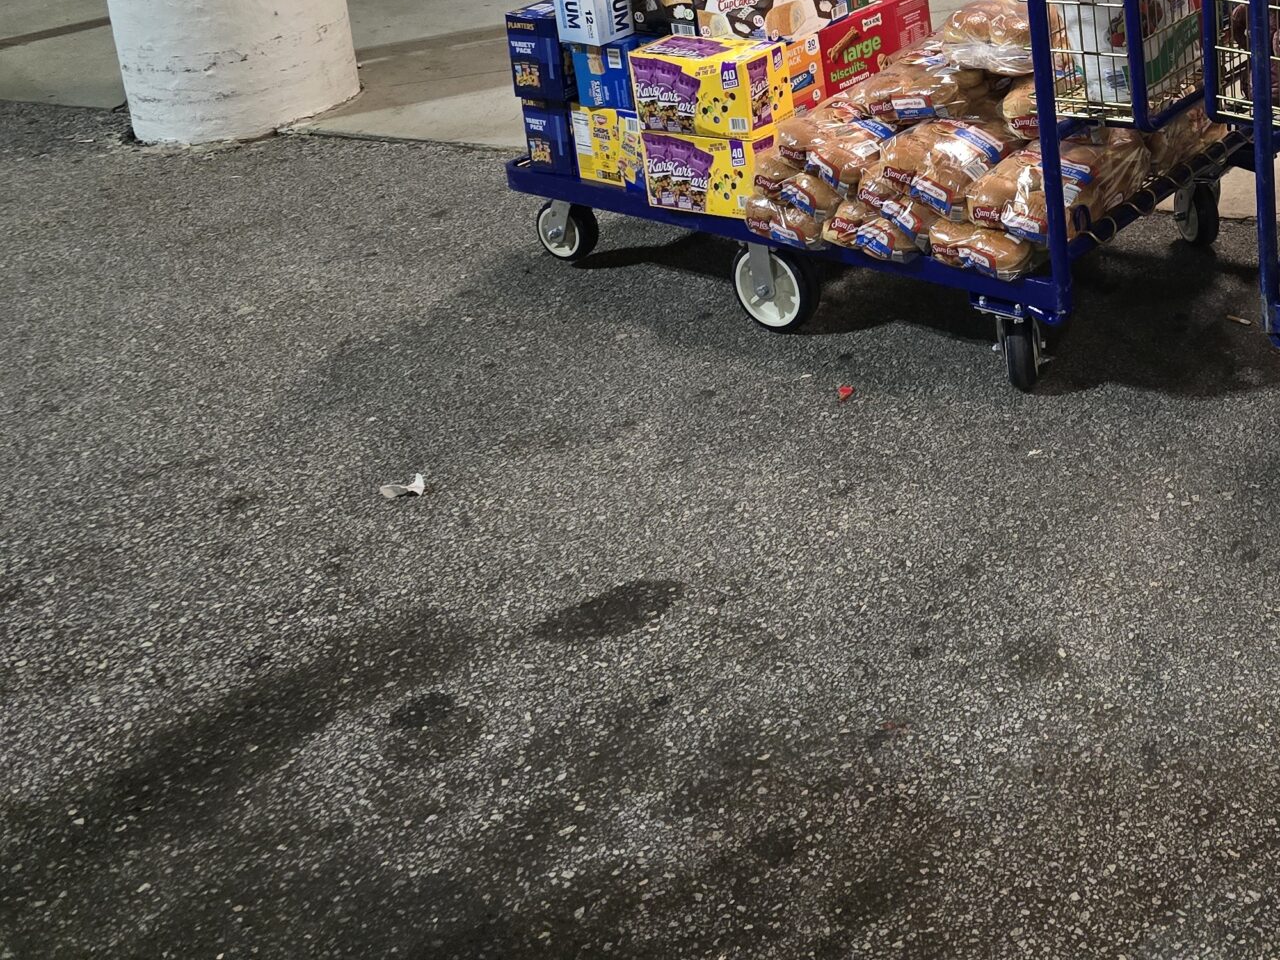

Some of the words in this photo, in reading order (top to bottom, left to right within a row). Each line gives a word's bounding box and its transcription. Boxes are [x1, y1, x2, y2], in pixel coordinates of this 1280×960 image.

[585, 9, 594, 24] 12
[754, 16, 762, 24] 16
[863, 16, 880, 26] MILK-BONE
[508, 22, 535, 30] PLANTERS
[702, 27, 710, 35] 16
[510, 40, 535, 48] VARIETY
[807, 38, 815, 48] 30
[843, 35, 881, 63] large
[722, 70, 736, 80] 40
[830, 61, 868, 82] biscuits,
[840, 72, 869, 89] maximum
[657, 87, 681, 102] Kar's
[870, 103, 882, 114] Sara
[525, 118, 546, 126] VARIETY
[1013, 118, 1029, 129] Sara
[593, 132, 610, 140] DELUXE
[732, 148, 743, 158] 40
[648, 159, 671, 172] Kar's
[669, 163, 694, 177] Kar's
[884, 167, 900, 181] Sara
[756, 176, 770, 188] Sara
[859, 190, 872, 203] Sara
[974, 207, 989, 218] Sara
[831, 218, 847, 230] Sara
